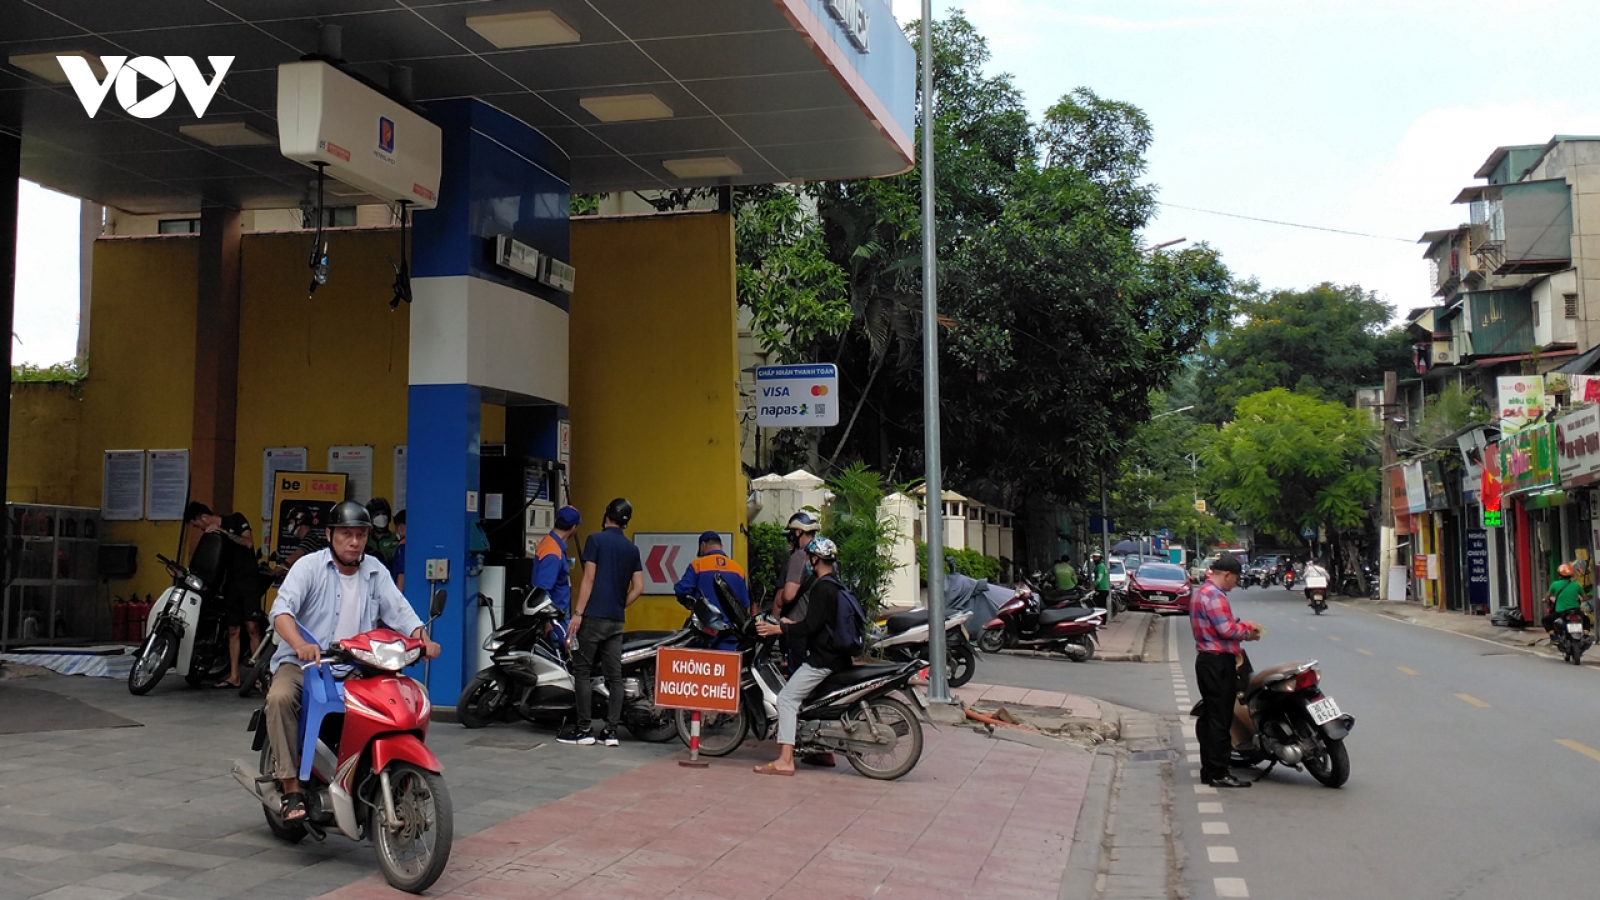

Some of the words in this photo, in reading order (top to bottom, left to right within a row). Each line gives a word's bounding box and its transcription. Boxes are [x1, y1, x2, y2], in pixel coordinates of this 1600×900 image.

[793, 368, 815, 376] THANH
[761, 386, 790, 397] VISA
[760, 405, 798, 418] napas
[282, 478, 301, 490] be
[311, 482, 339, 492] CAKE
[672, 658, 711, 676] KHÔNG
[713, 663, 726, 677] ĐI
[660, 681, 699, 699] NGƯỢC
[701, 682, 735, 700] CHIỀU
